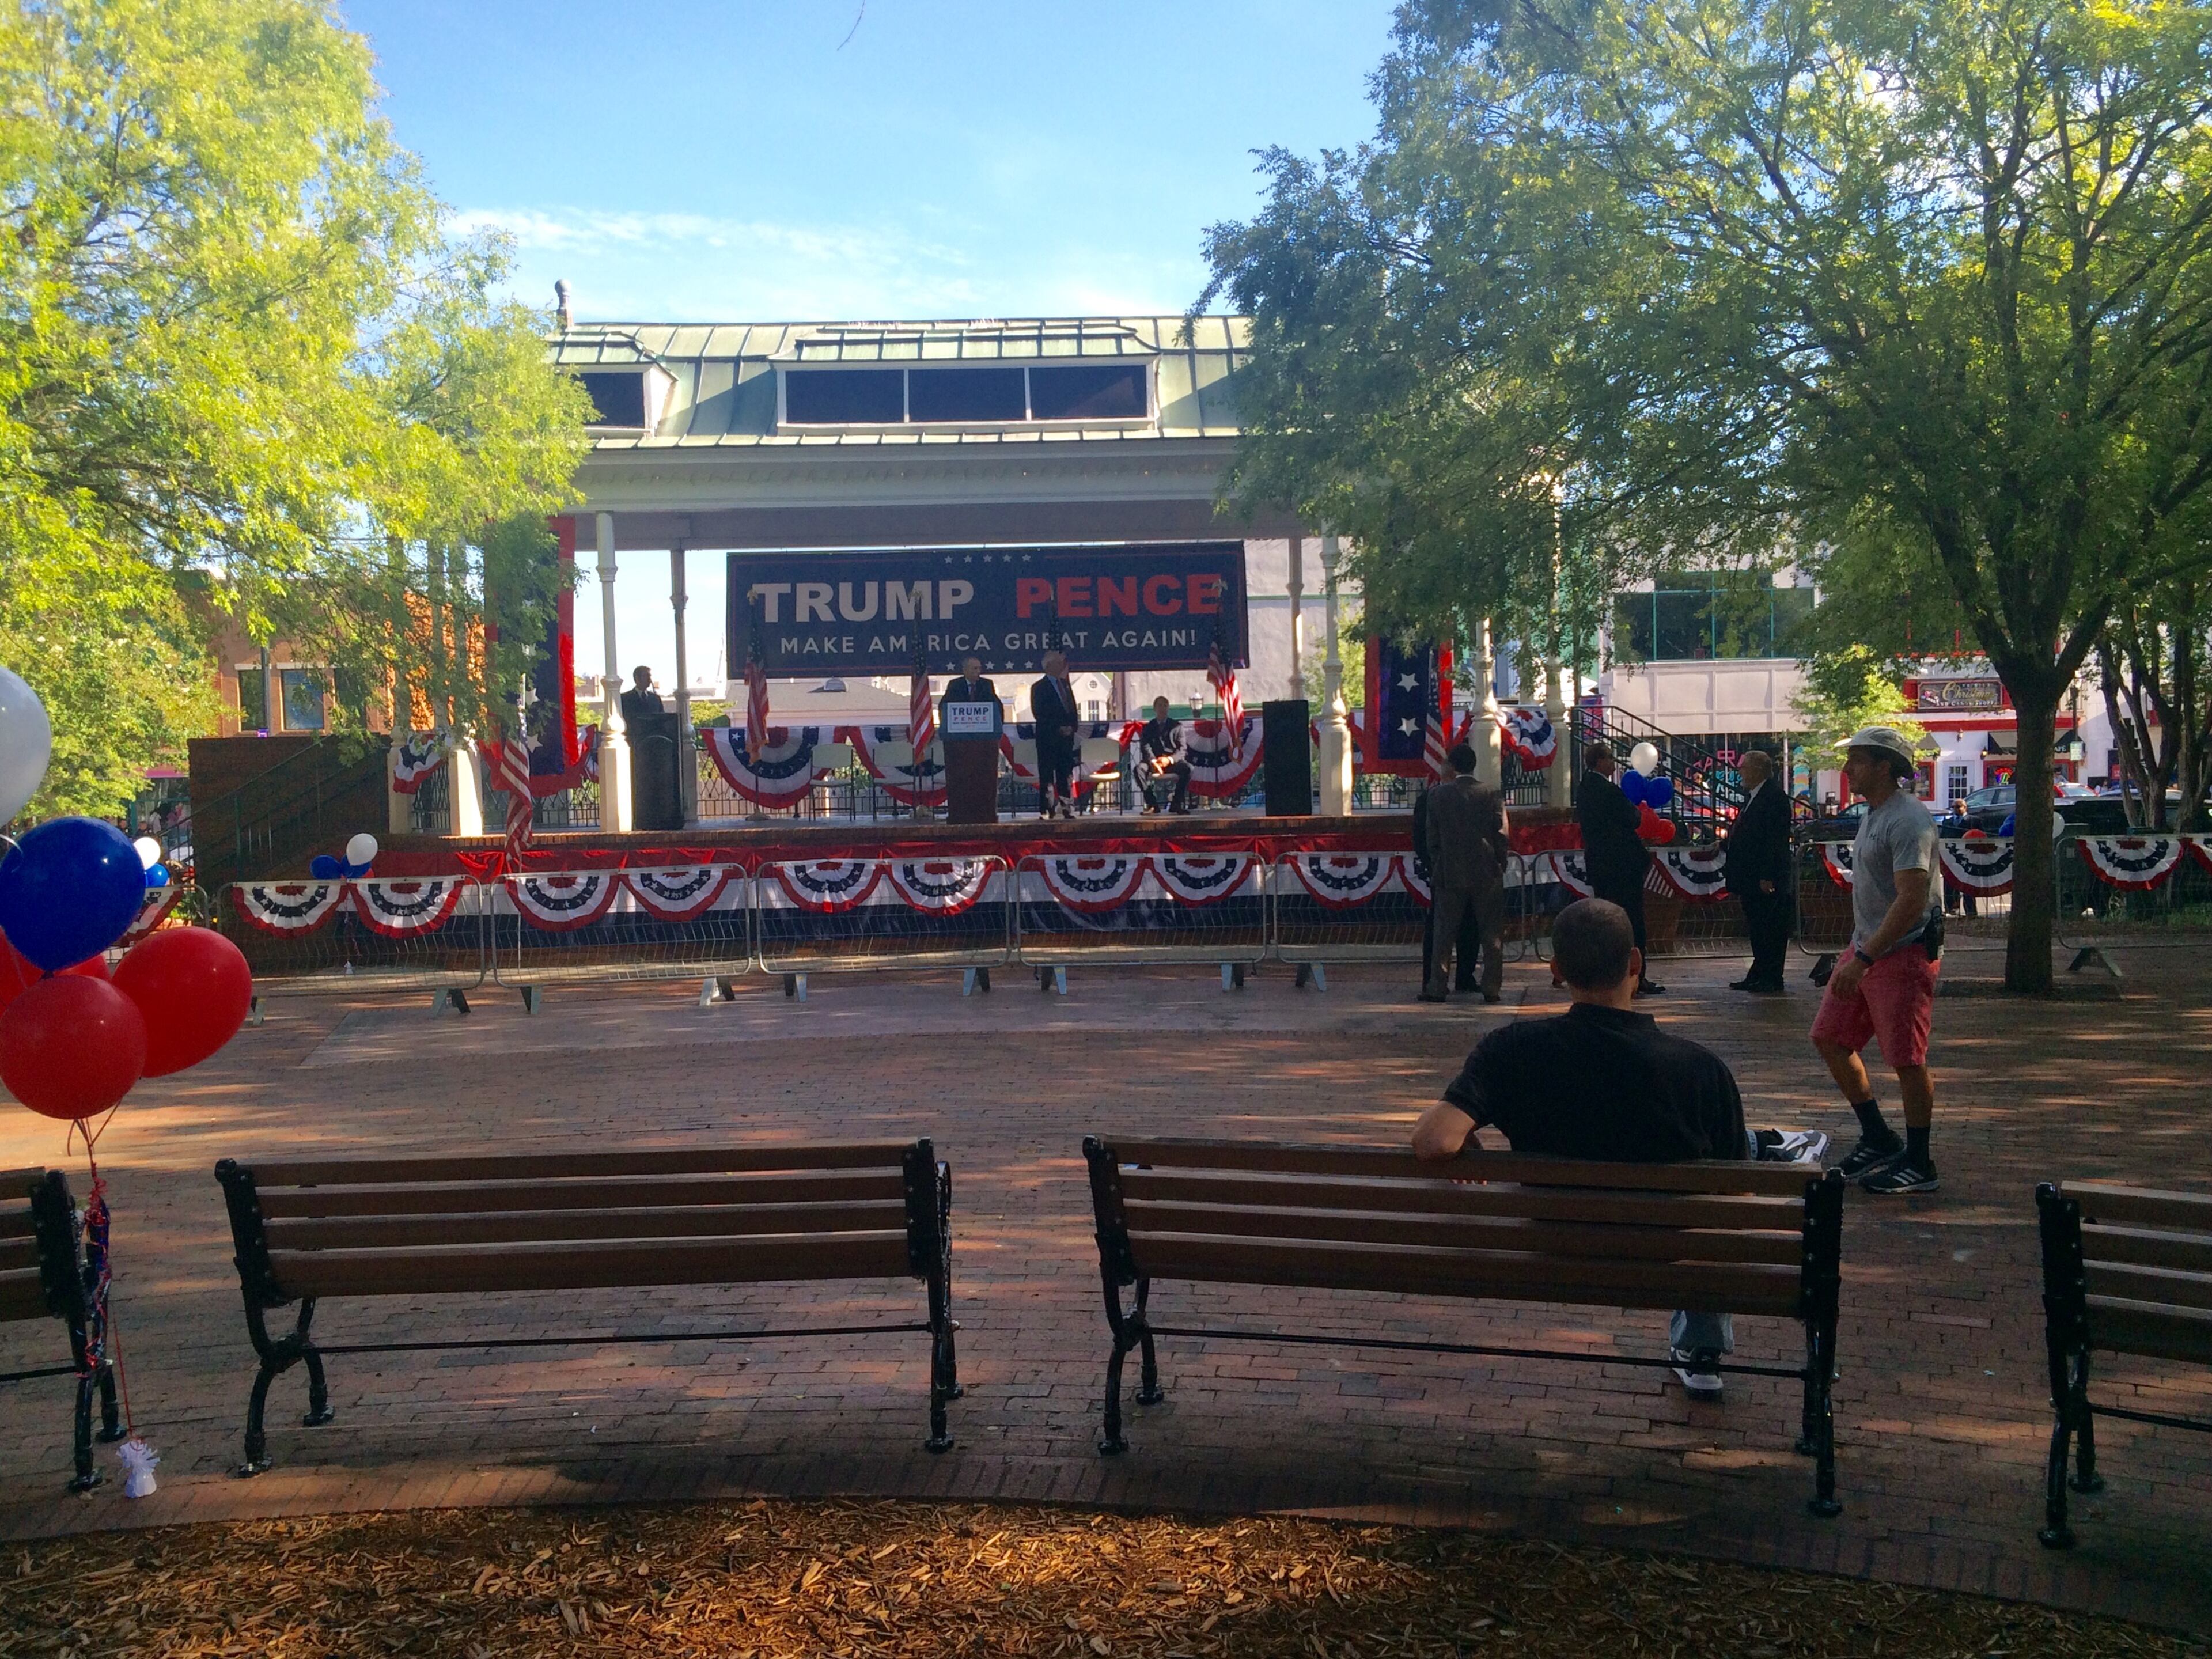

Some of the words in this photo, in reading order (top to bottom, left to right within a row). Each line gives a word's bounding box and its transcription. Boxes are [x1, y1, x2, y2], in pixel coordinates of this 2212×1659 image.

[752, 579, 974, 623] TRUMP
[1016, 574, 1222, 618] PENCE
[781, 636, 854, 654] MAKE
[868, 634, 991, 653] AMRICA
[1102, 630, 1196, 647] AGAIN!
[952, 707, 989, 715] TRUMP
